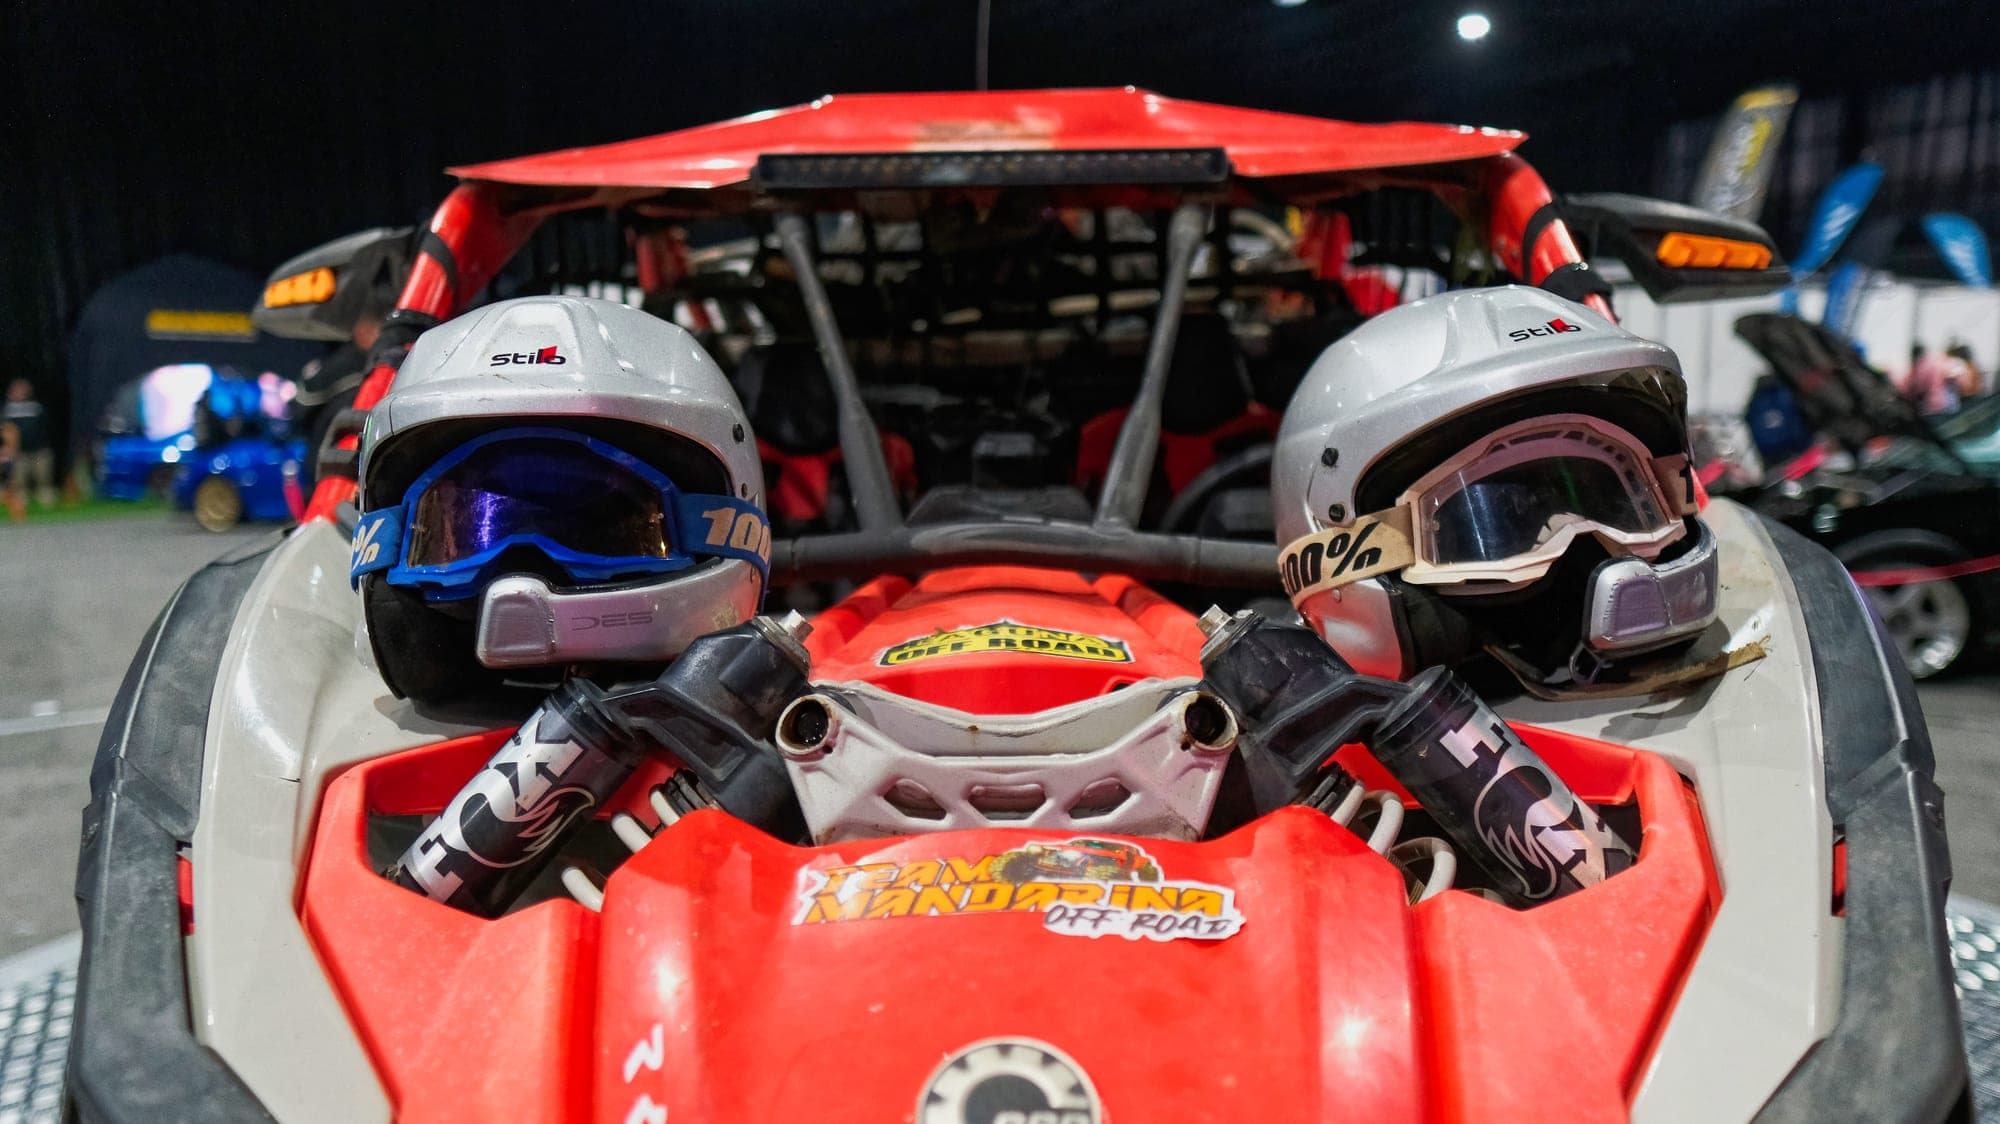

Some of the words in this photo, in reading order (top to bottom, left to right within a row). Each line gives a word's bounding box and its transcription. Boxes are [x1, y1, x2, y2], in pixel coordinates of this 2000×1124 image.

[571, 611, 654, 632] DES
[896, 640, 974, 662] OFF
[987, 637, 1117, 658] ROAD
[411, 707, 596, 904] FOX
[1438, 704, 1640, 899] FOX
[819, 854, 998, 894] TEAM
[1045, 904, 1123, 929] OFF
[1128, 912, 1233, 935] ROAD
